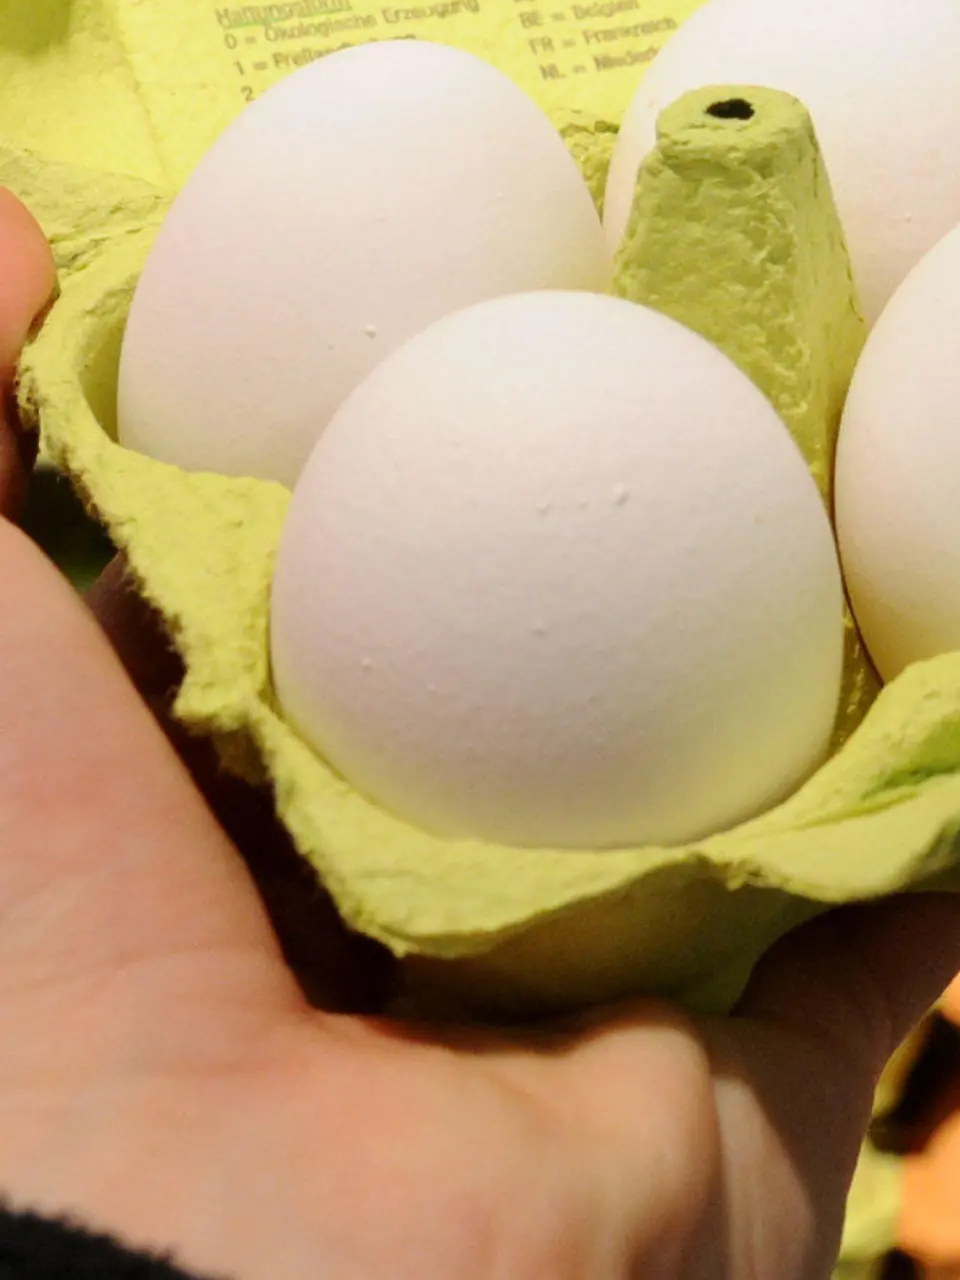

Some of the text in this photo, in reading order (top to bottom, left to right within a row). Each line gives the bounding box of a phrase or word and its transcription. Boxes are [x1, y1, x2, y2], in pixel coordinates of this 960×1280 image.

[224, 33, 238, 51] 0
[528, 35, 555, 56] FR
[233, 59, 246, 77] 1
[240, 84, 256, 103] 2
